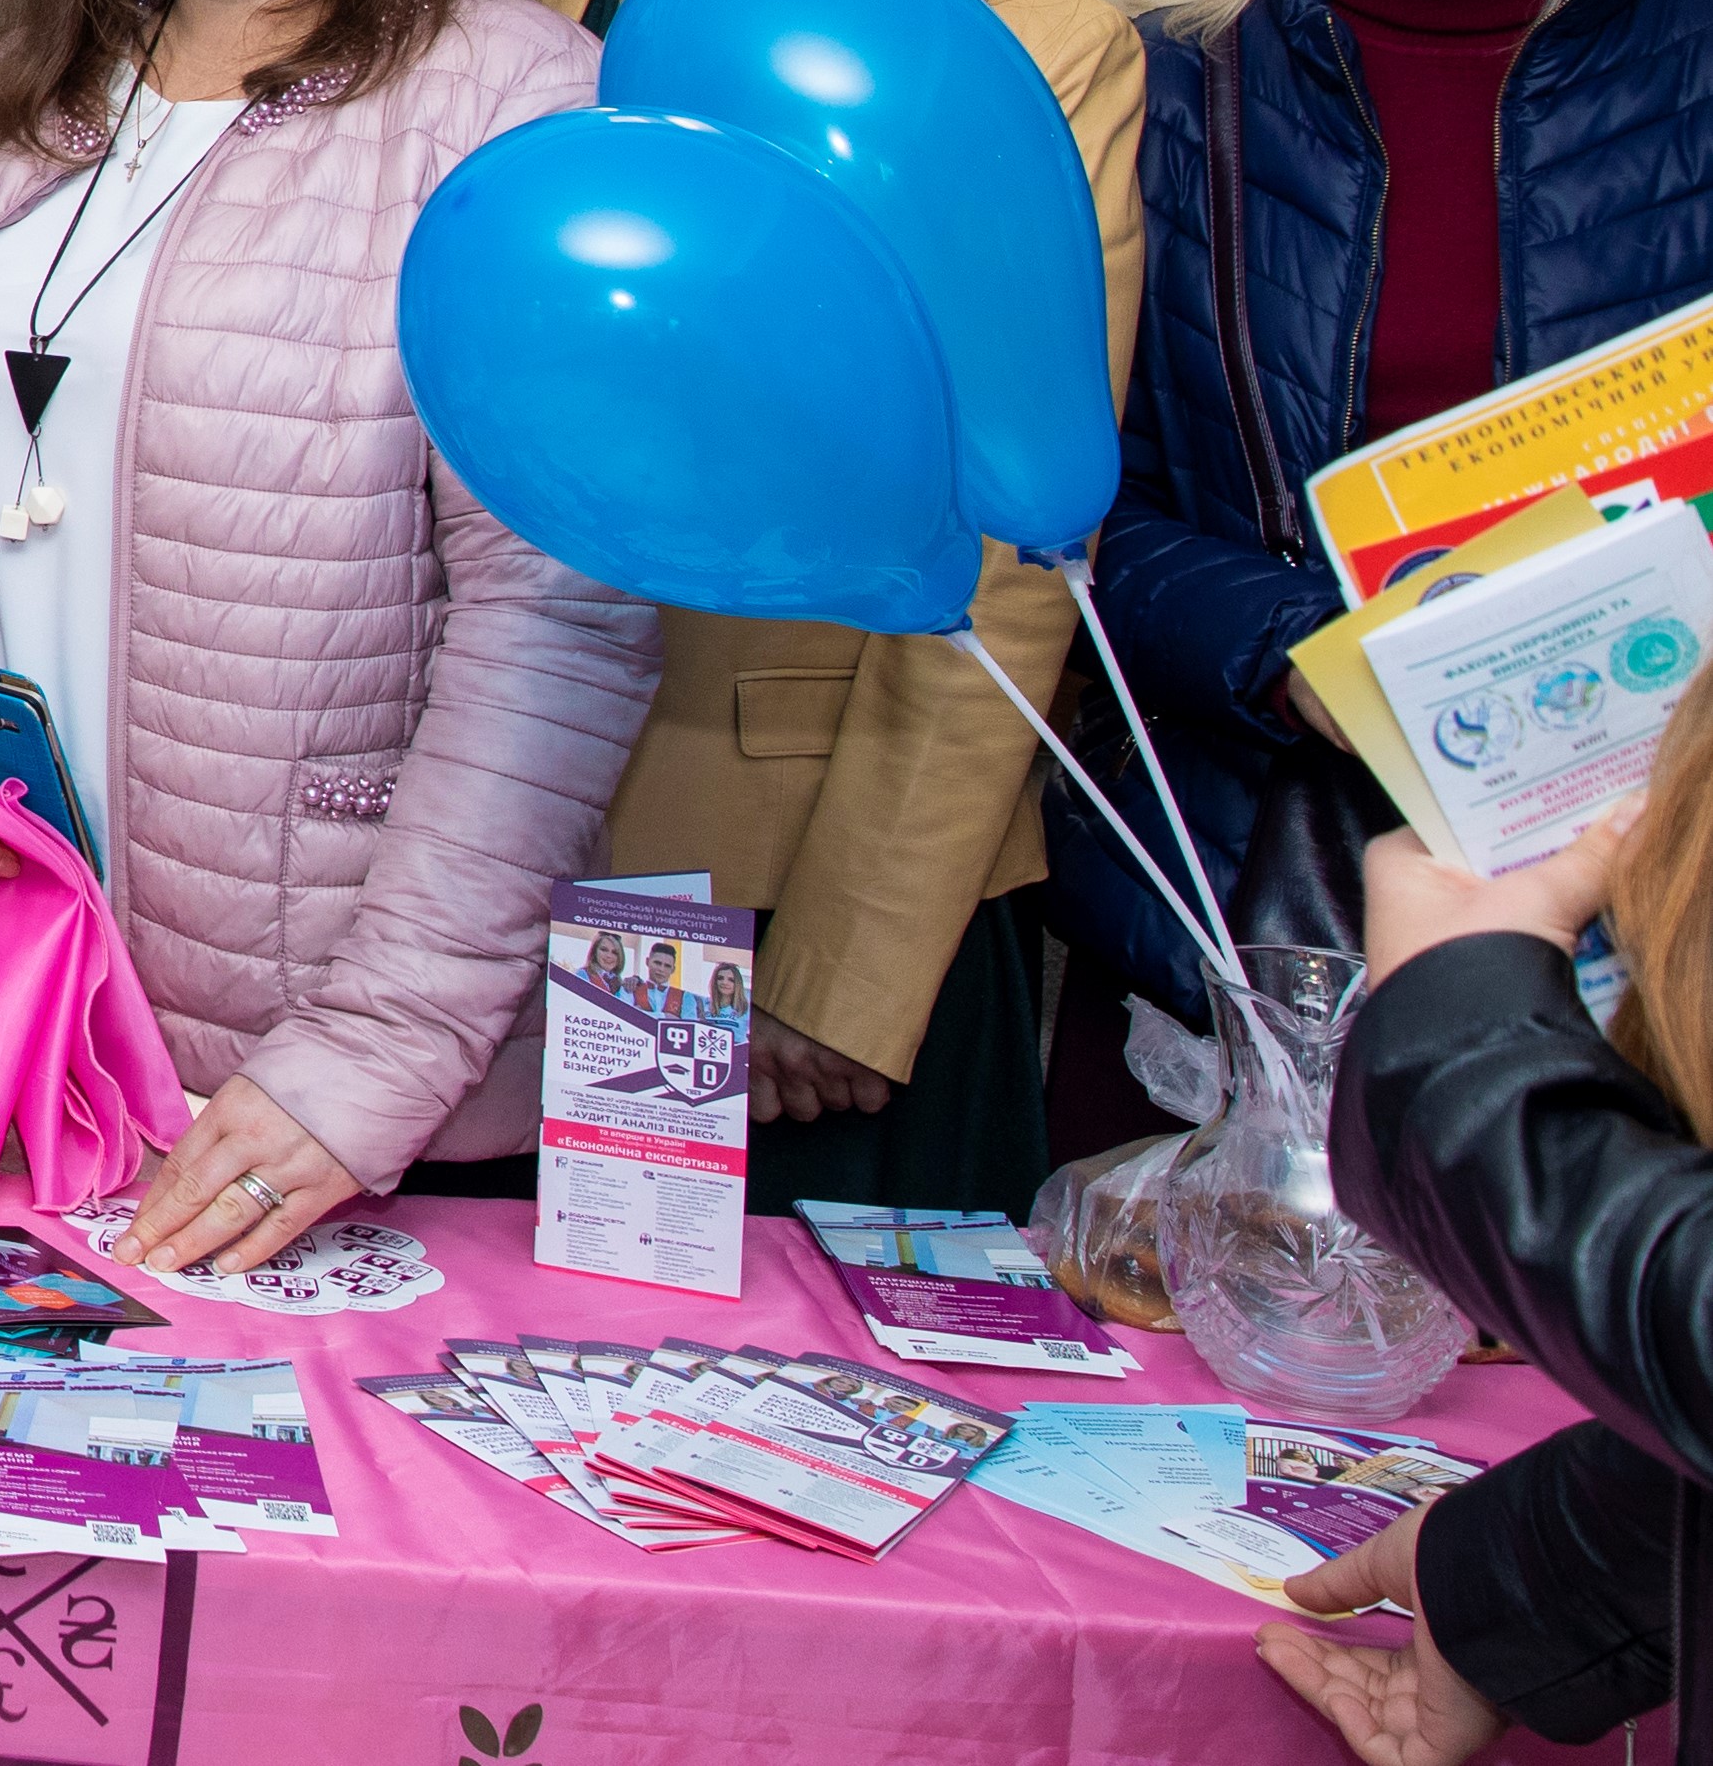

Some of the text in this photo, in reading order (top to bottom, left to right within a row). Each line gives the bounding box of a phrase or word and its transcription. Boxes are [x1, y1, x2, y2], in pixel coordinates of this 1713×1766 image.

[1398, 346, 1667, 470] ТЕРНОПІЛЬСЬКИЙ
[1449, 370, 1667, 473] ЕКОНОМІЧНИЙ
[578, 896, 728, 924] ТЕРНОПІЛЬСЬКИЙ НАЦІОНАЛЬНИЙ
[589, 906, 714, 931] ЕКОНОМІЧНИЙ УНІВЕРСИТЕТ
[574, 915, 728, 944] ФАКУЛЬТЕТ ФІНАНСІВ ТА ОБЛІКУ
[565, 1015, 622, 1032] КАФЕДРА
[564, 1026, 649, 1048] ЕКОНОМІЧНОЇ
[564, 1037, 641, 1058] ЕКСПЕРТИЗИ
[563, 1049, 631, 1068] ТА АУДИТУ
[563, 1061, 613, 1076] БІЗНЕСУ
[566, 1109, 610, 1124] «АУДИТ
[621, 1118, 665, 1132] АНАЛІЗ
[668, 1123, 724, 1141] БІЗНЕСУ»
[610, 1130, 644, 1143] вперше
[653, 1135, 686, 1148] Україні
[557, 1136, 642, 1159] «Економічна
[645, 1150, 729, 1172] експертиза»
[867, 1276, 955, 1289] ЗАПРОШУЄМО
[771, 1394, 834, 1416] КАФЕДРА
[718, 1431, 906, 1502] «Економічна експертиза»
